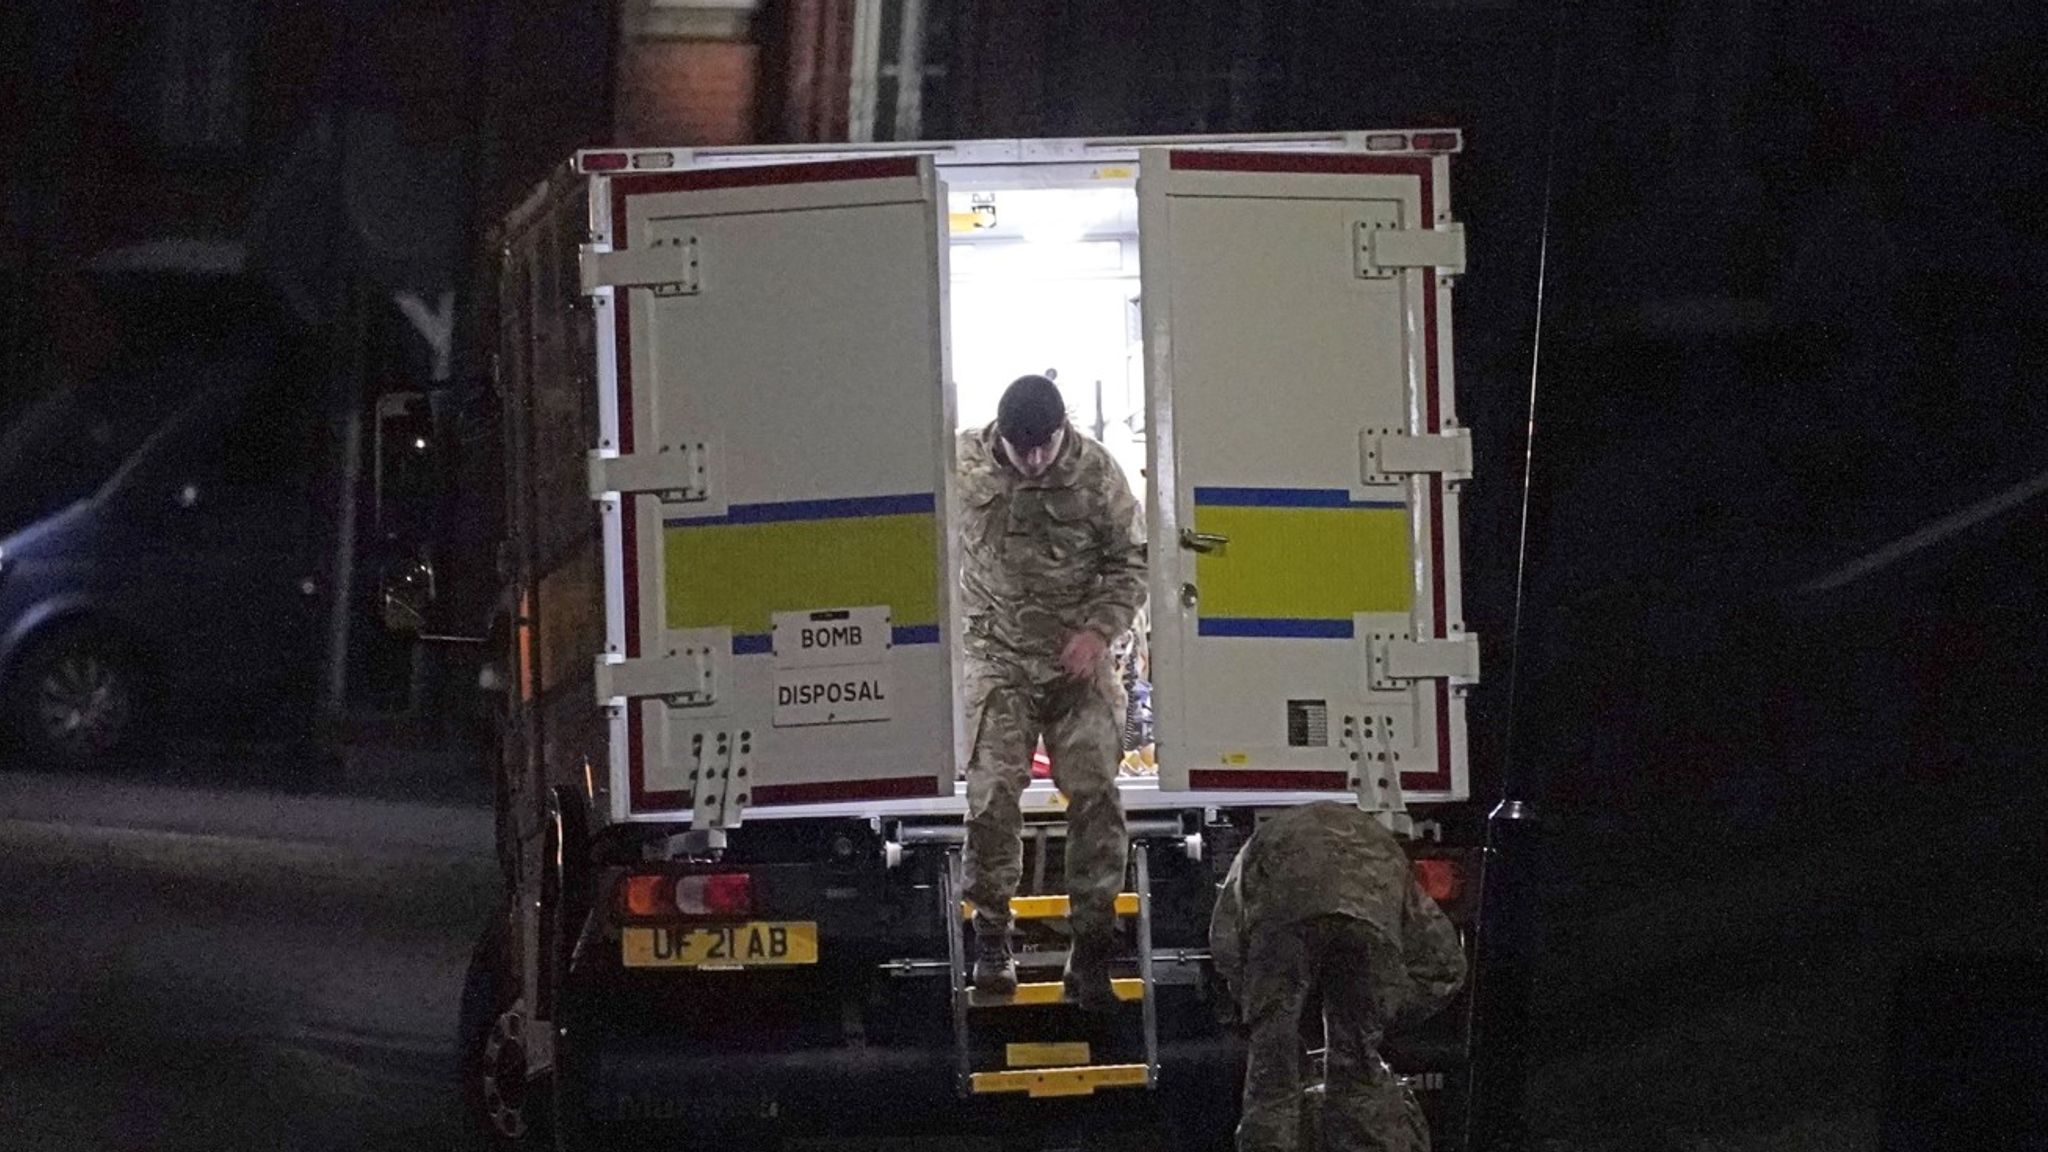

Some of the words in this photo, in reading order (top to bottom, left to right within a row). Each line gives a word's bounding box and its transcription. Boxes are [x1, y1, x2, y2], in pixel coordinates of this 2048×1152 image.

[801, 626, 862, 649] BOMB
[778, 680, 885, 706] DISPOSAL
[706, 928, 736, 959] 21
[747, 926, 788, 958] AB
